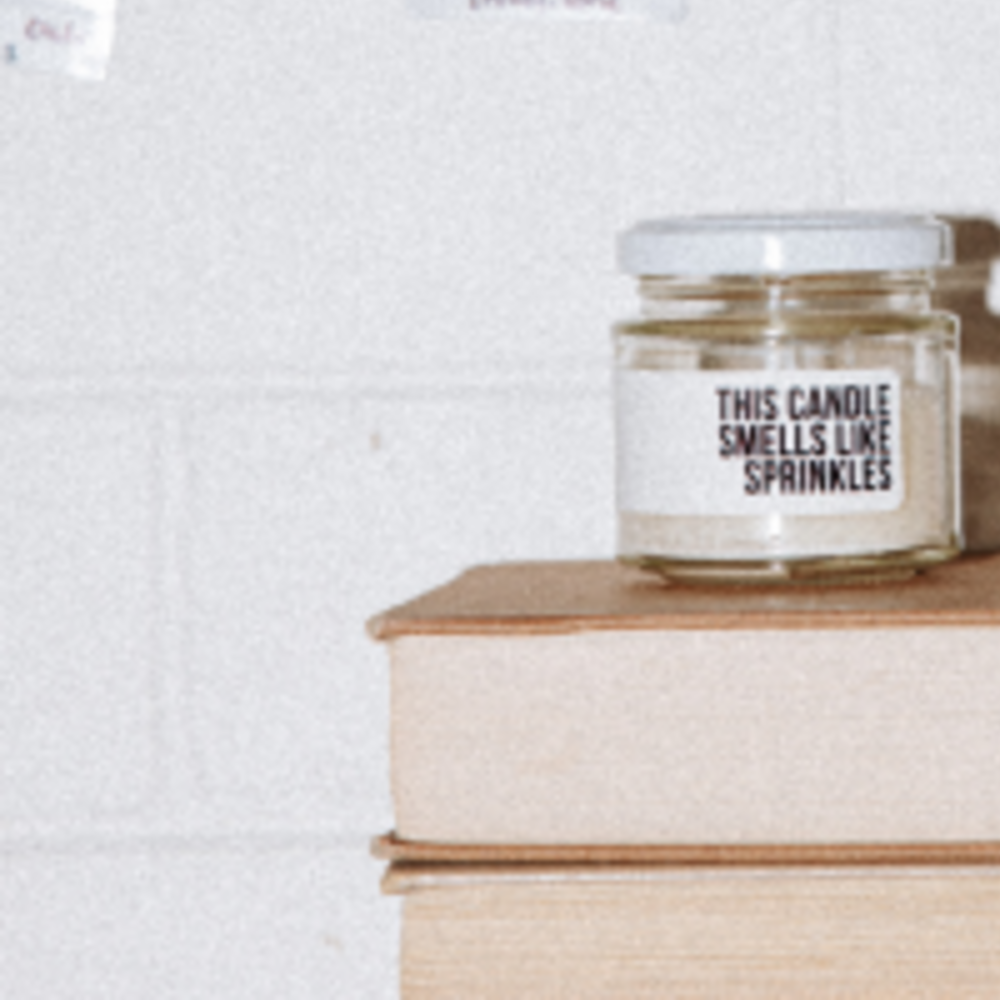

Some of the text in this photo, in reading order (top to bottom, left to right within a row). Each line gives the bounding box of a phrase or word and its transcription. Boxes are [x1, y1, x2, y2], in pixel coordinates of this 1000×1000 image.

[716, 383, 891, 421] THIS CANDLE
[718, 420, 891, 457] SMELLS LIKE
[743, 458, 892, 496] SPRINKLES
